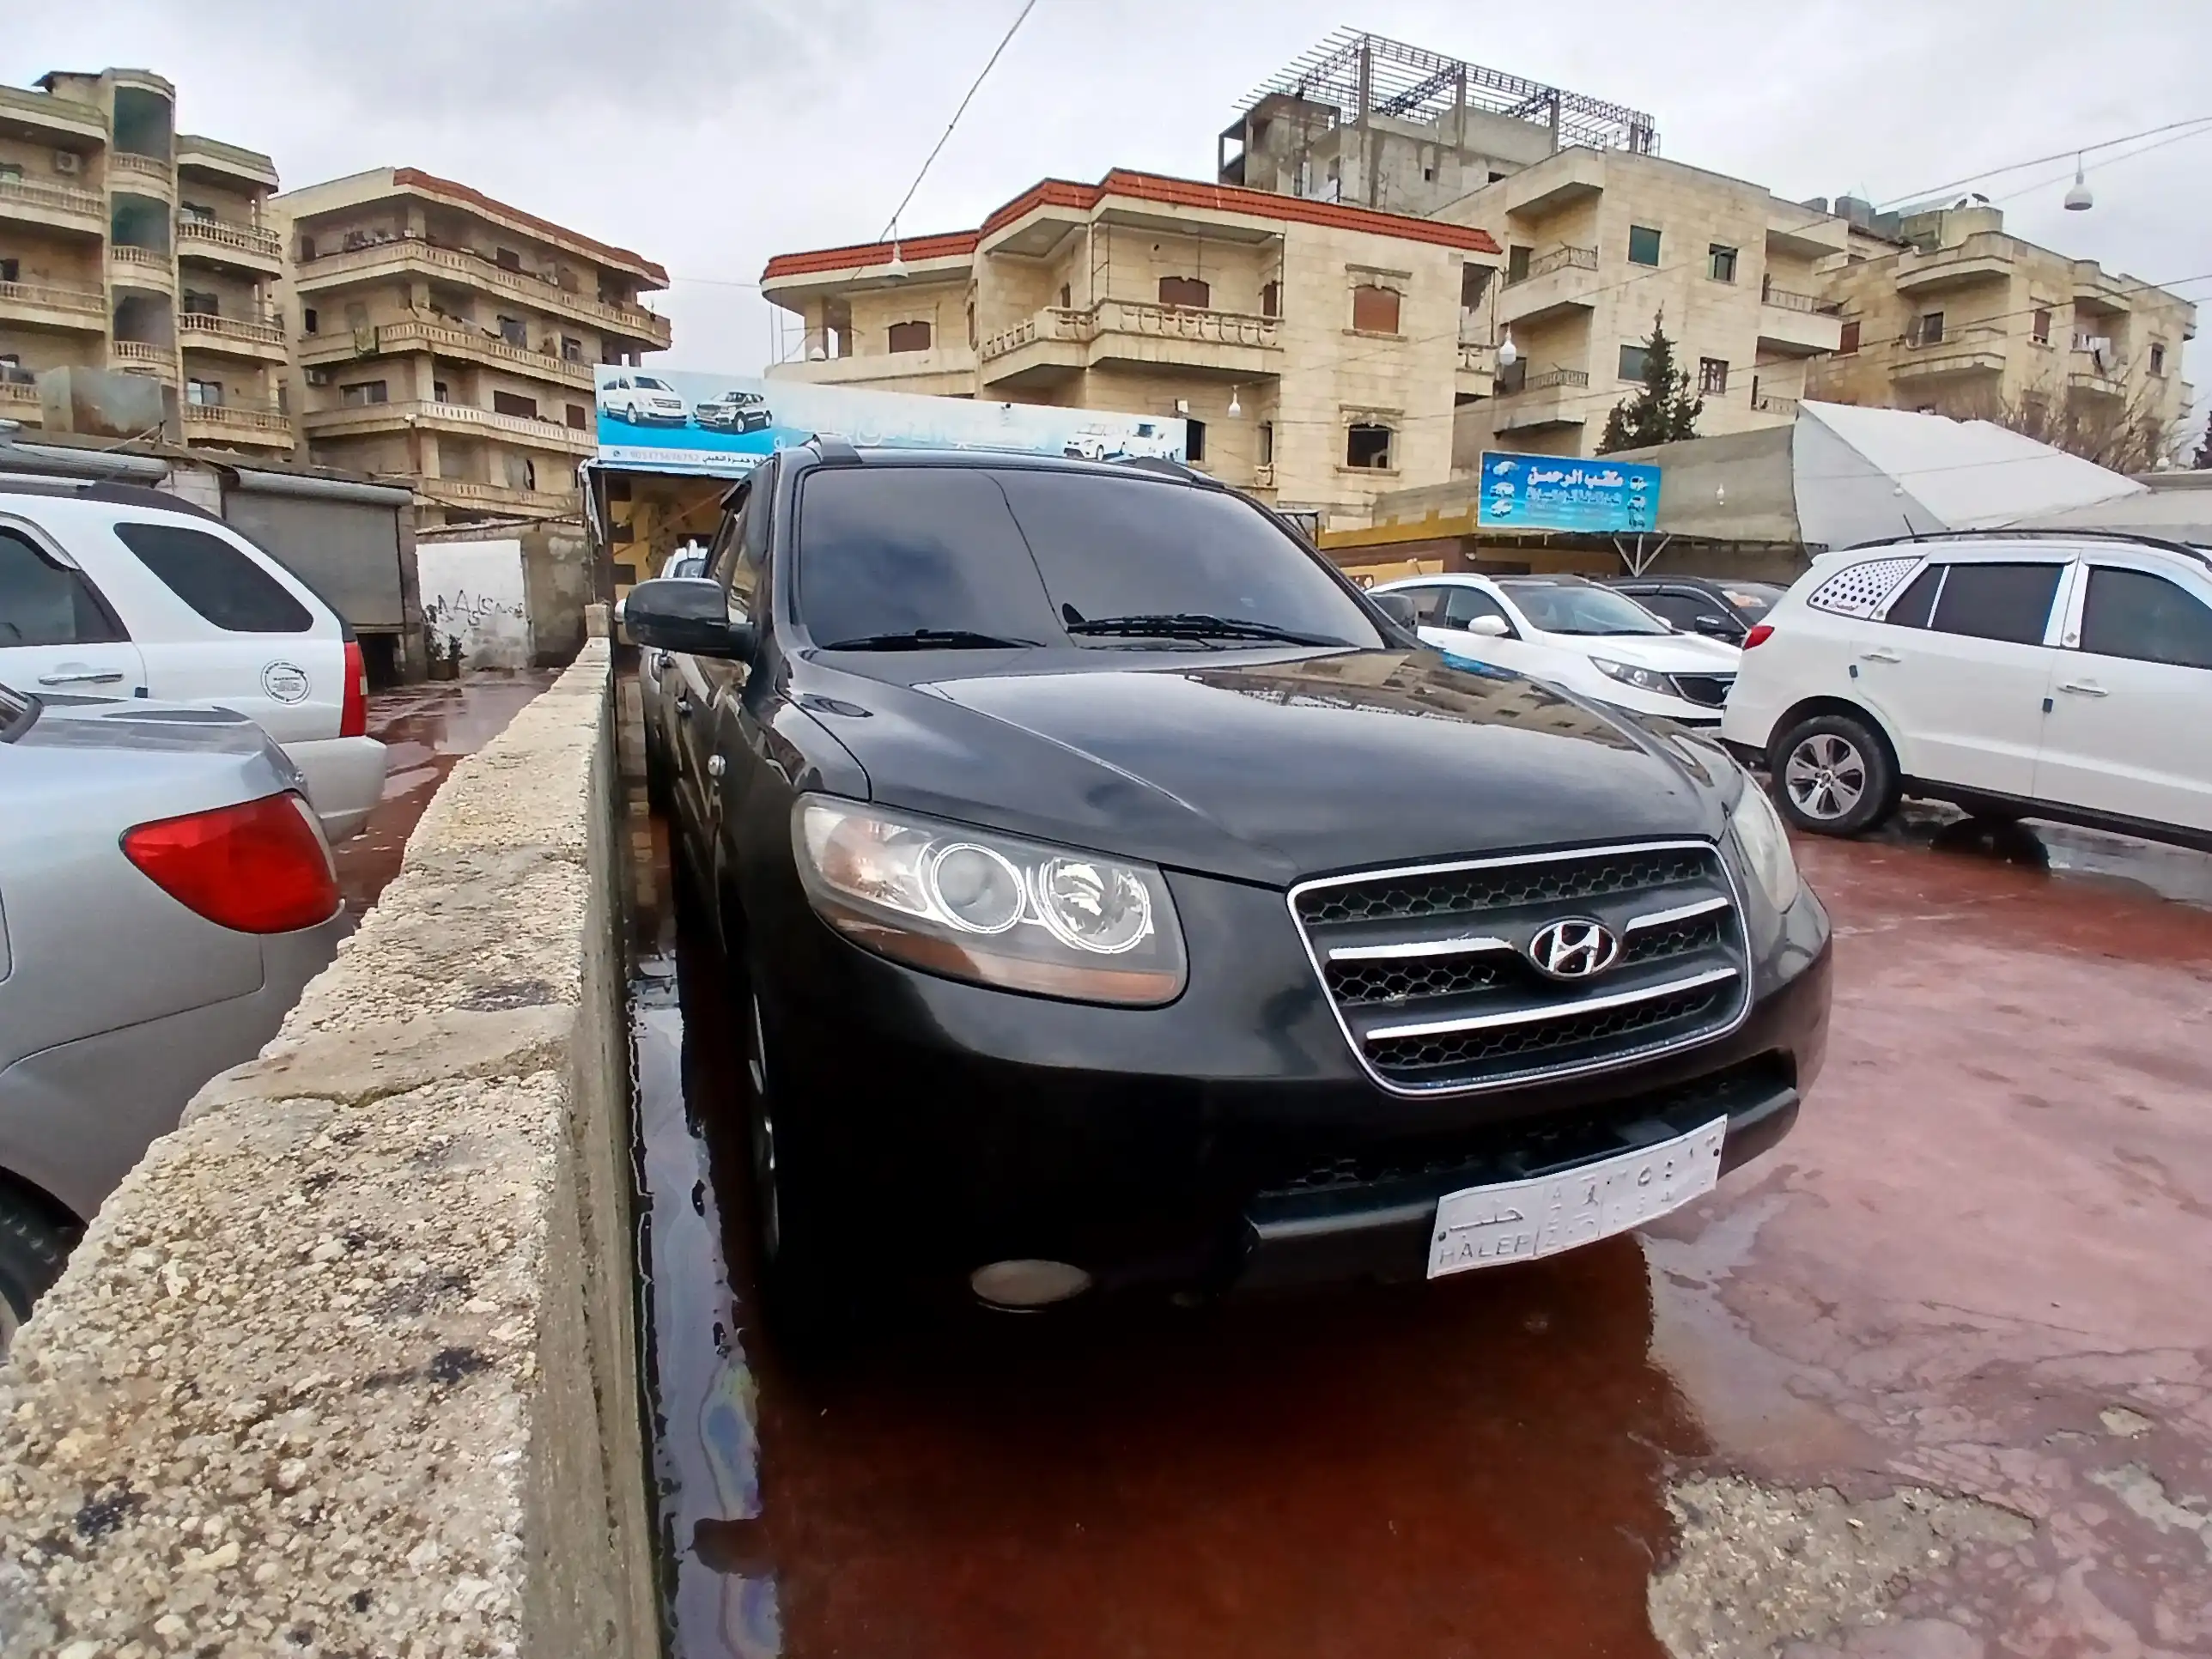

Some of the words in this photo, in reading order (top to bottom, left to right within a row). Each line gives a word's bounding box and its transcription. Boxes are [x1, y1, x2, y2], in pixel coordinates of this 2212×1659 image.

[1527, 466, 1583, 488] الرحمن
[1584, 470, 1623, 489] مكتب
[1449, 1197, 1525, 1239] حلب
[1438, 1233, 1531, 1265] HALEP
